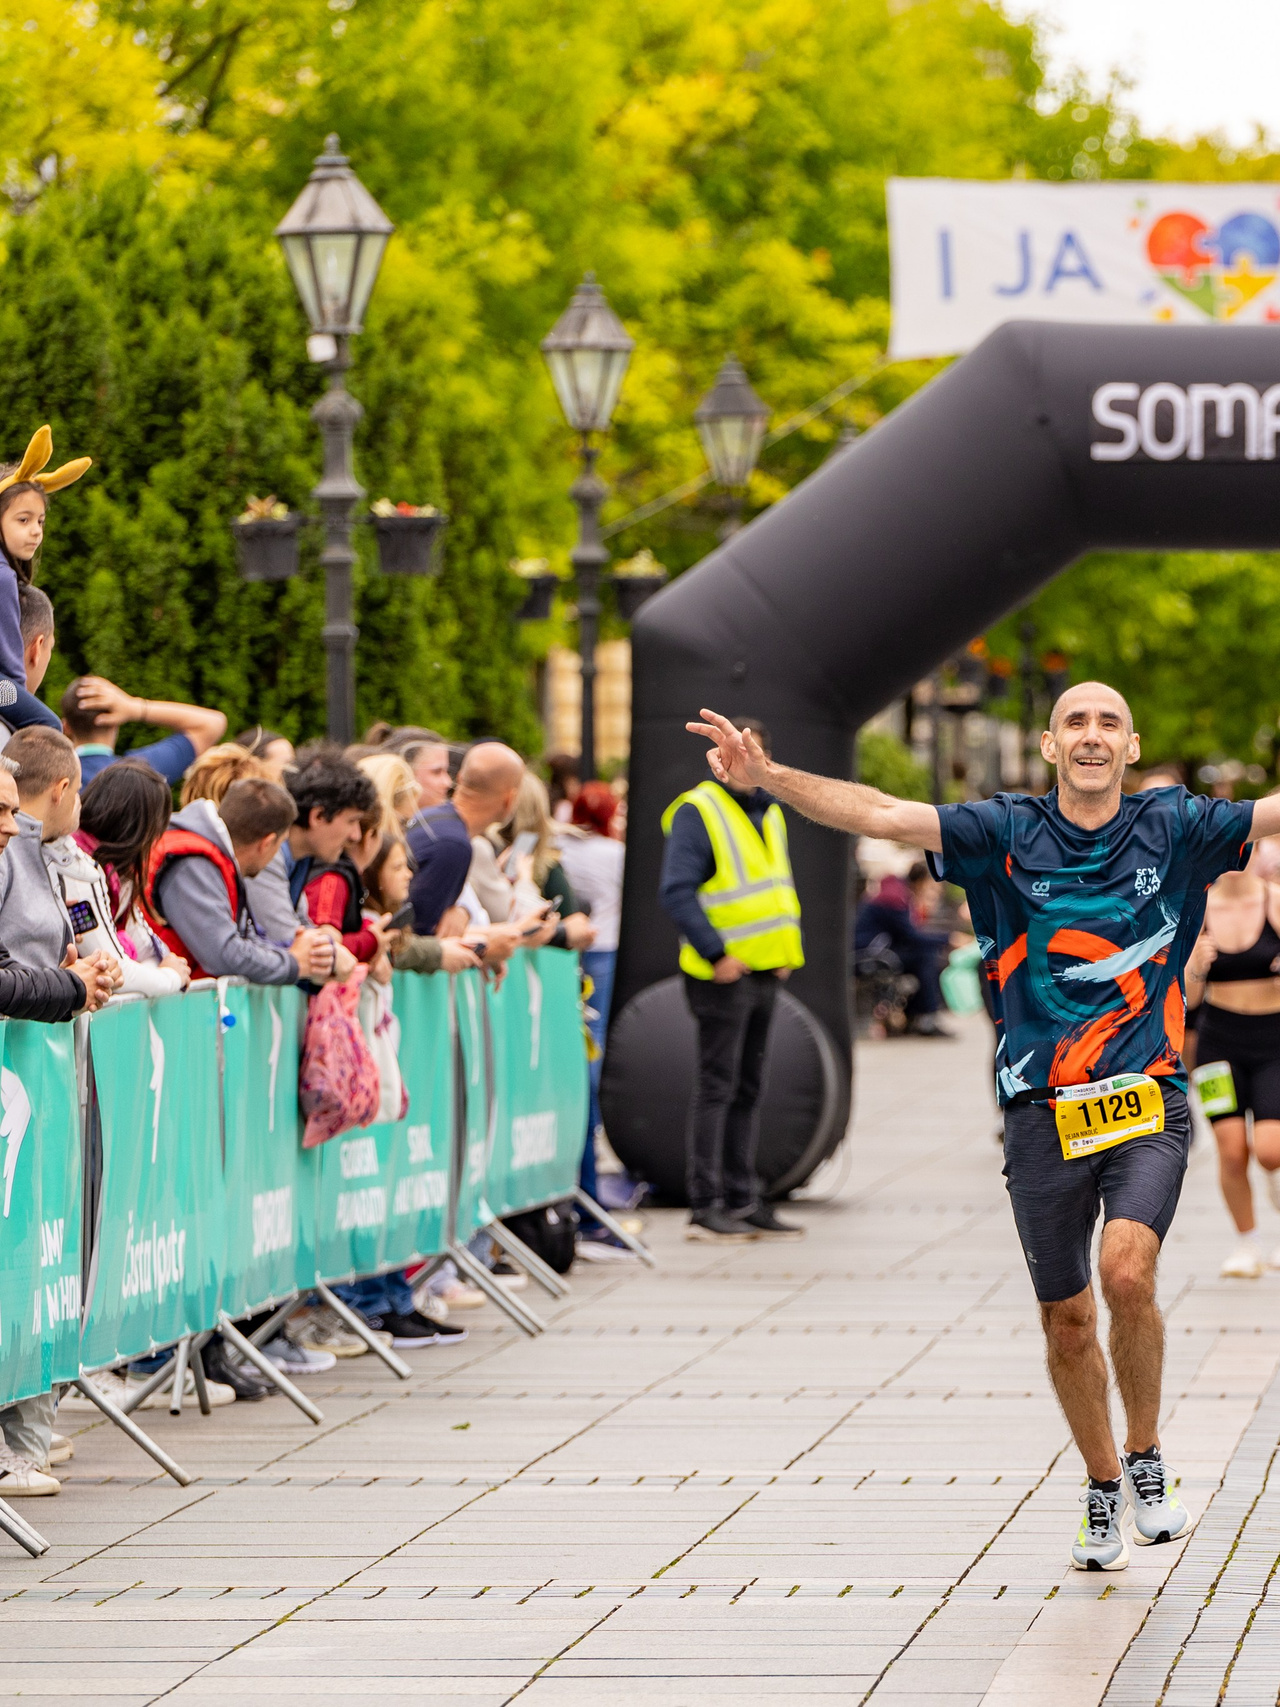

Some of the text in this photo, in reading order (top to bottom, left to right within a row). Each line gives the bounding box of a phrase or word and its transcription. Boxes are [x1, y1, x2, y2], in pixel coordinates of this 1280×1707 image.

[938, 228, 956, 300] I
[995, 228, 1104, 297] JA
[1077, 1090, 1142, 1128] 1129
[1065, 1127, 1099, 1140] DEJAN NIKOLIĆ
